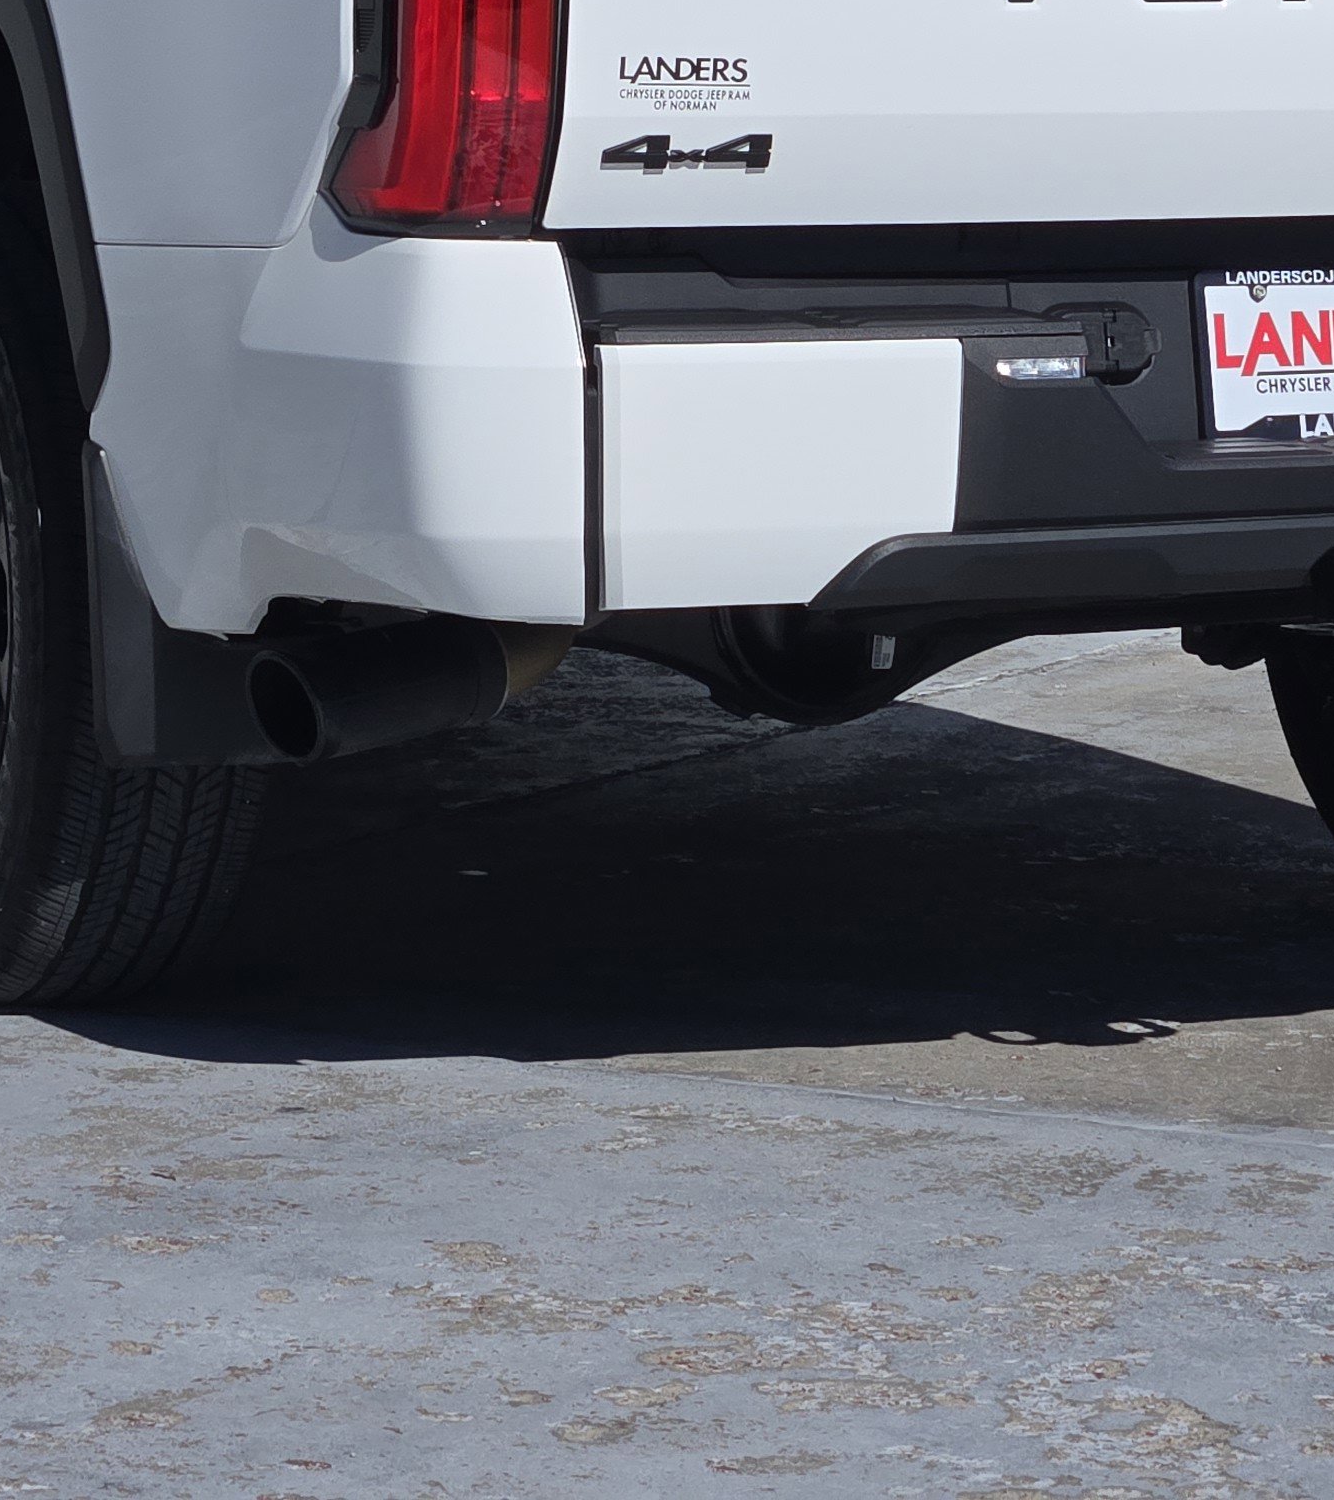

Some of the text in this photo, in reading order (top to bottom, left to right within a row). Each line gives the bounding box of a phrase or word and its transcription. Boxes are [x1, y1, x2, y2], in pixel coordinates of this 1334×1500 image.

[619, 56, 748, 84] LANDERS
[619, 88, 750, 100] CHRYSLER DODGE JEEP RAM
[654, 100, 716, 111] OF NORMAN
[1256, 376, 1331, 394] CHRYSLER
